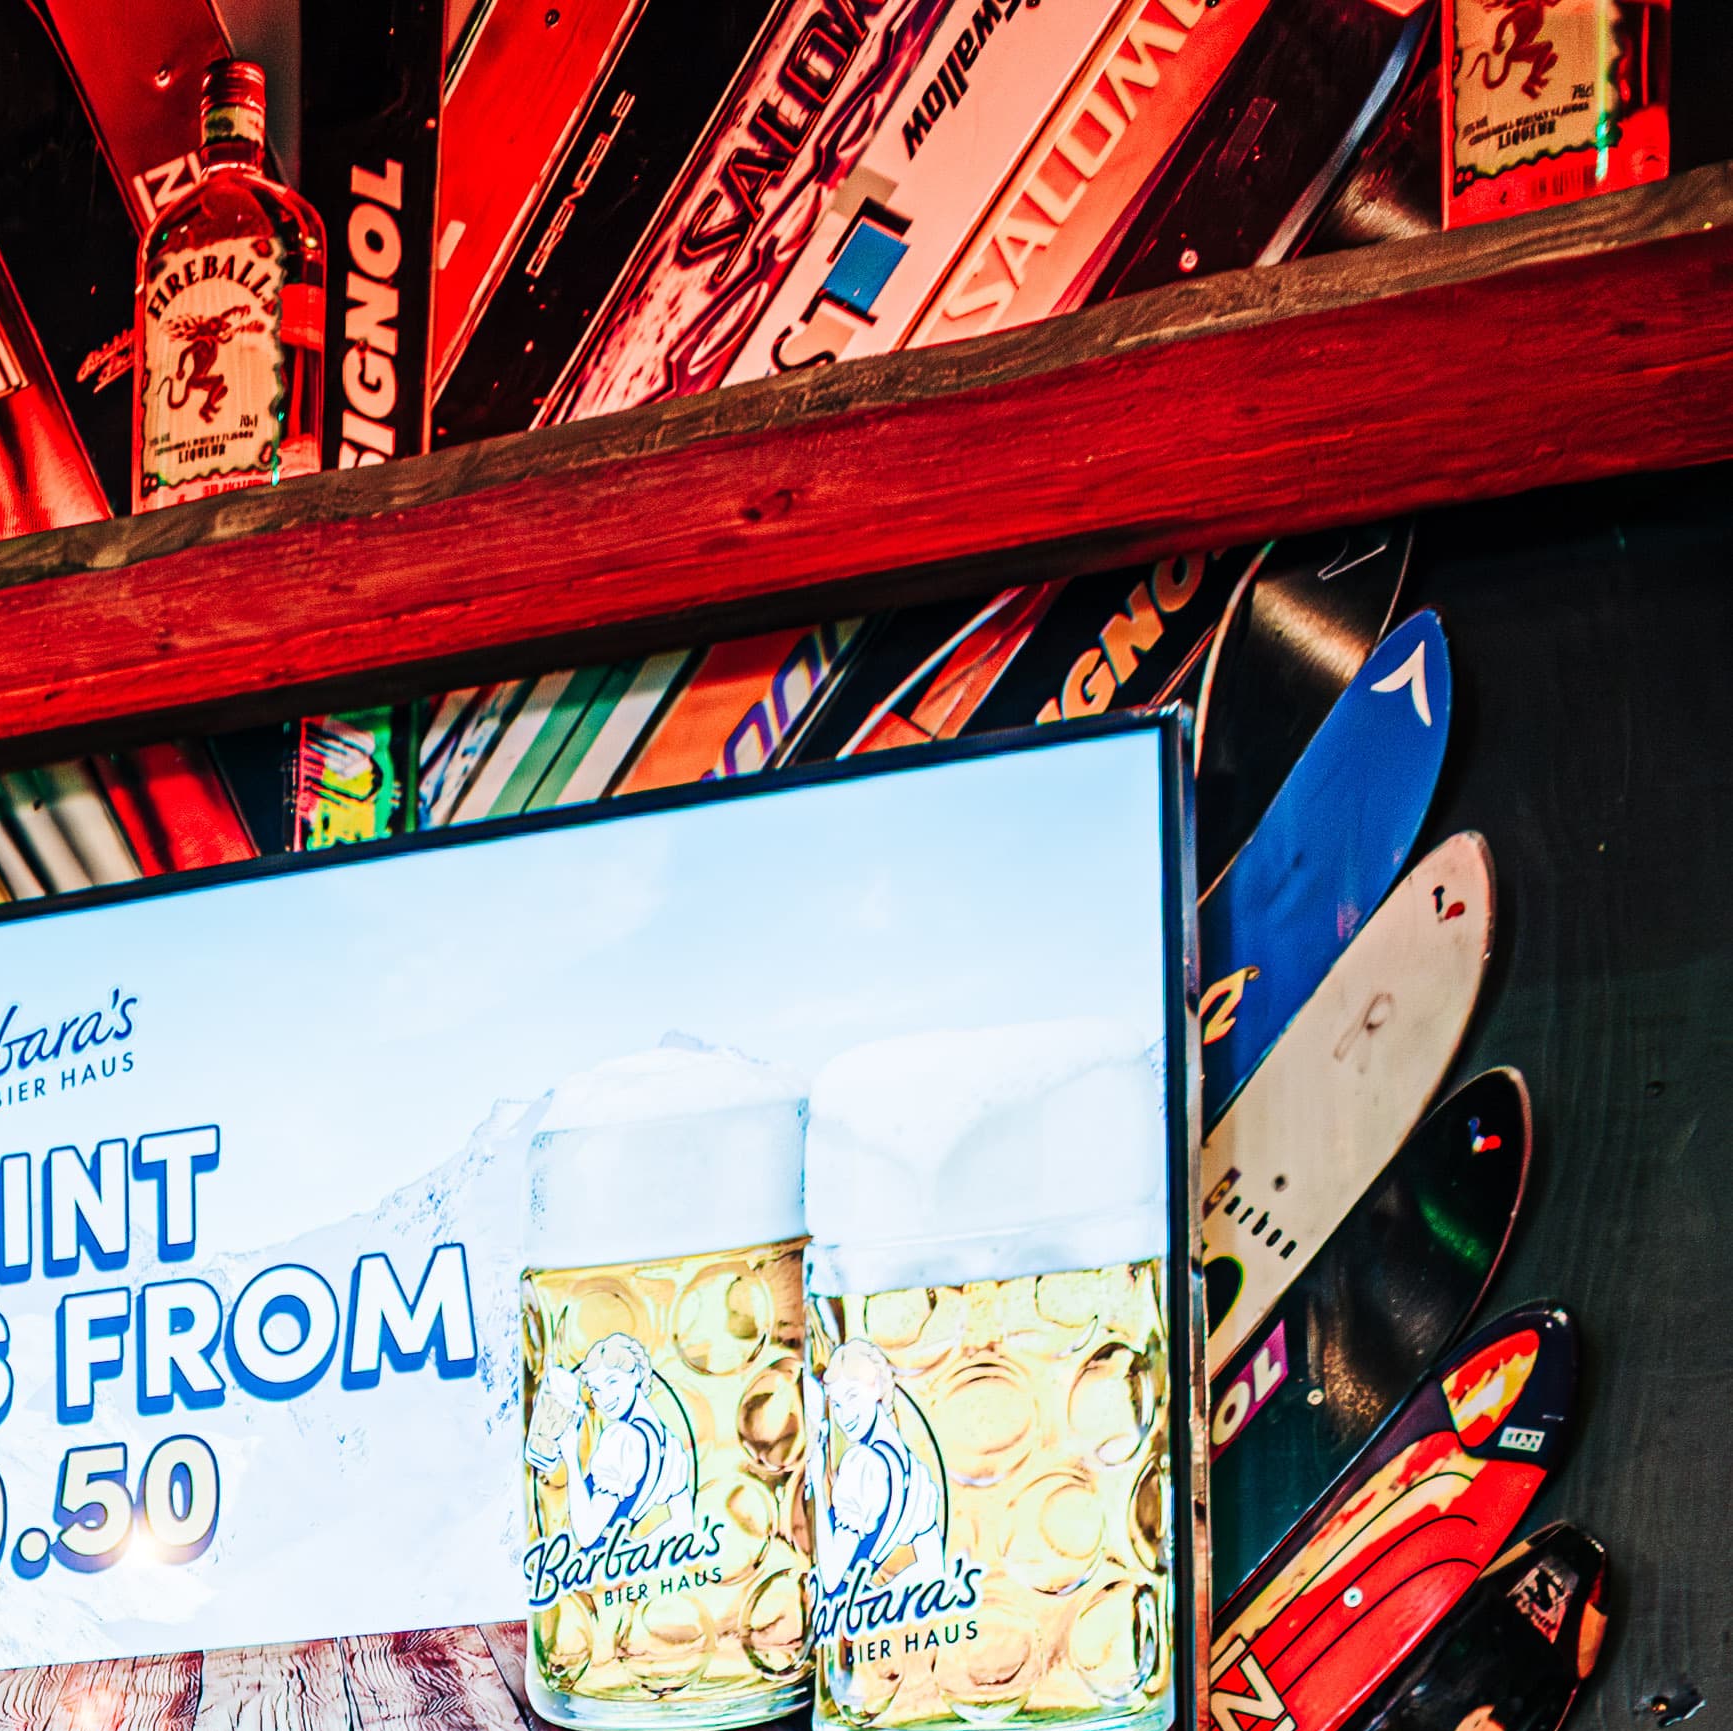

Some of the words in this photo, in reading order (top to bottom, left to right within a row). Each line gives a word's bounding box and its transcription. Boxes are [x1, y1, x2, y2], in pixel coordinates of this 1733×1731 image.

[146, 254, 269, 320] FIREBALL
[61, 1052, 134, 1095] HAUS
[58, 1243, 476, 1422] FROM
[524, 1516, 725, 1609] Barbara's
[604, 1582, 648, 1606] BIER
[659, 1567, 722, 1595] HAUS
[904, 1622, 980, 1654] HAUS
